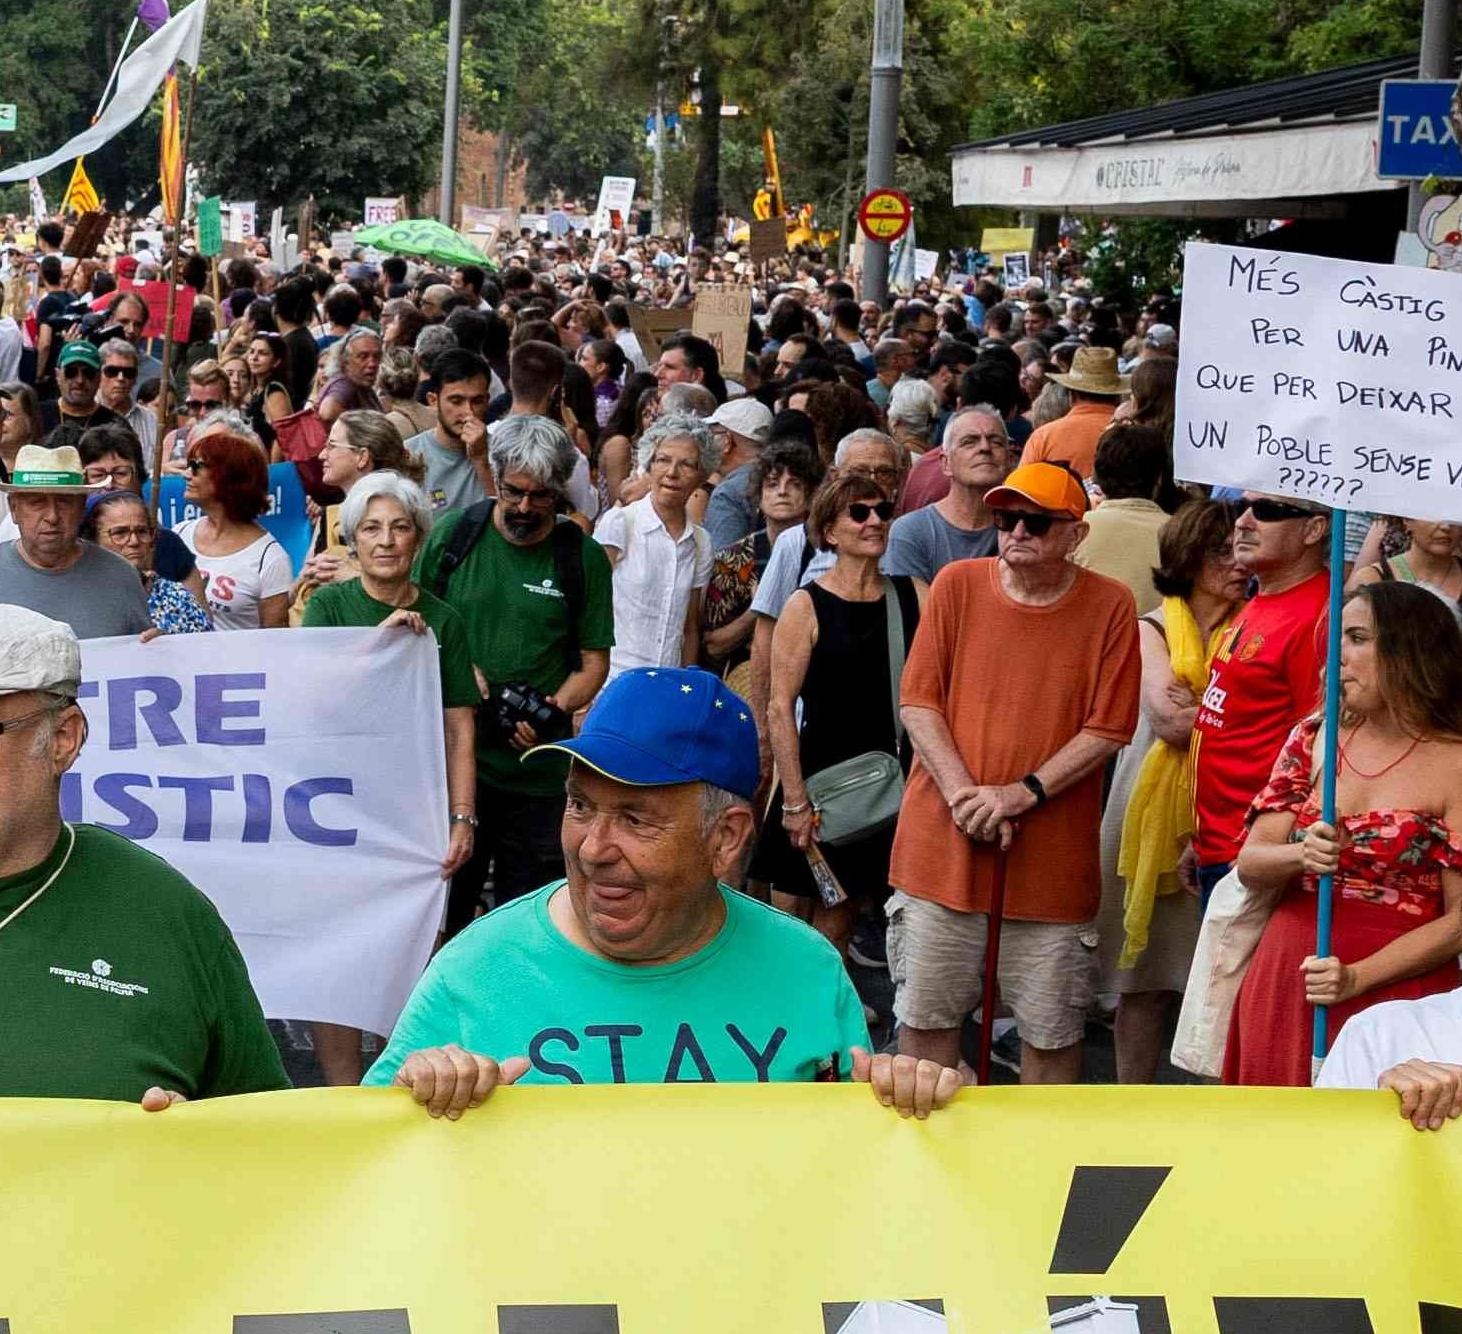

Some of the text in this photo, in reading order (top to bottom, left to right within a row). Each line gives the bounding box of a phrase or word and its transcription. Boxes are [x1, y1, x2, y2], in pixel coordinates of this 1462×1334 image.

[1386, 115, 1462, 145] TAX
[1229, 255, 1445, 322] MÉS CÀSTIG
[1251, 318, 1304, 346] PER
[1337, 329, 1390, 357] UNA
[1196, 364, 1255, 393] QUE
[1273, 372, 1318, 400] PER
[1188, 421, 1228, 449] UN
[1257, 425, 1333, 466] POBLE
[1354, 446, 1433, 481] SENSE
[1279, 467, 1364, 505] ??????
[528, 1022, 787, 1084] STAY
